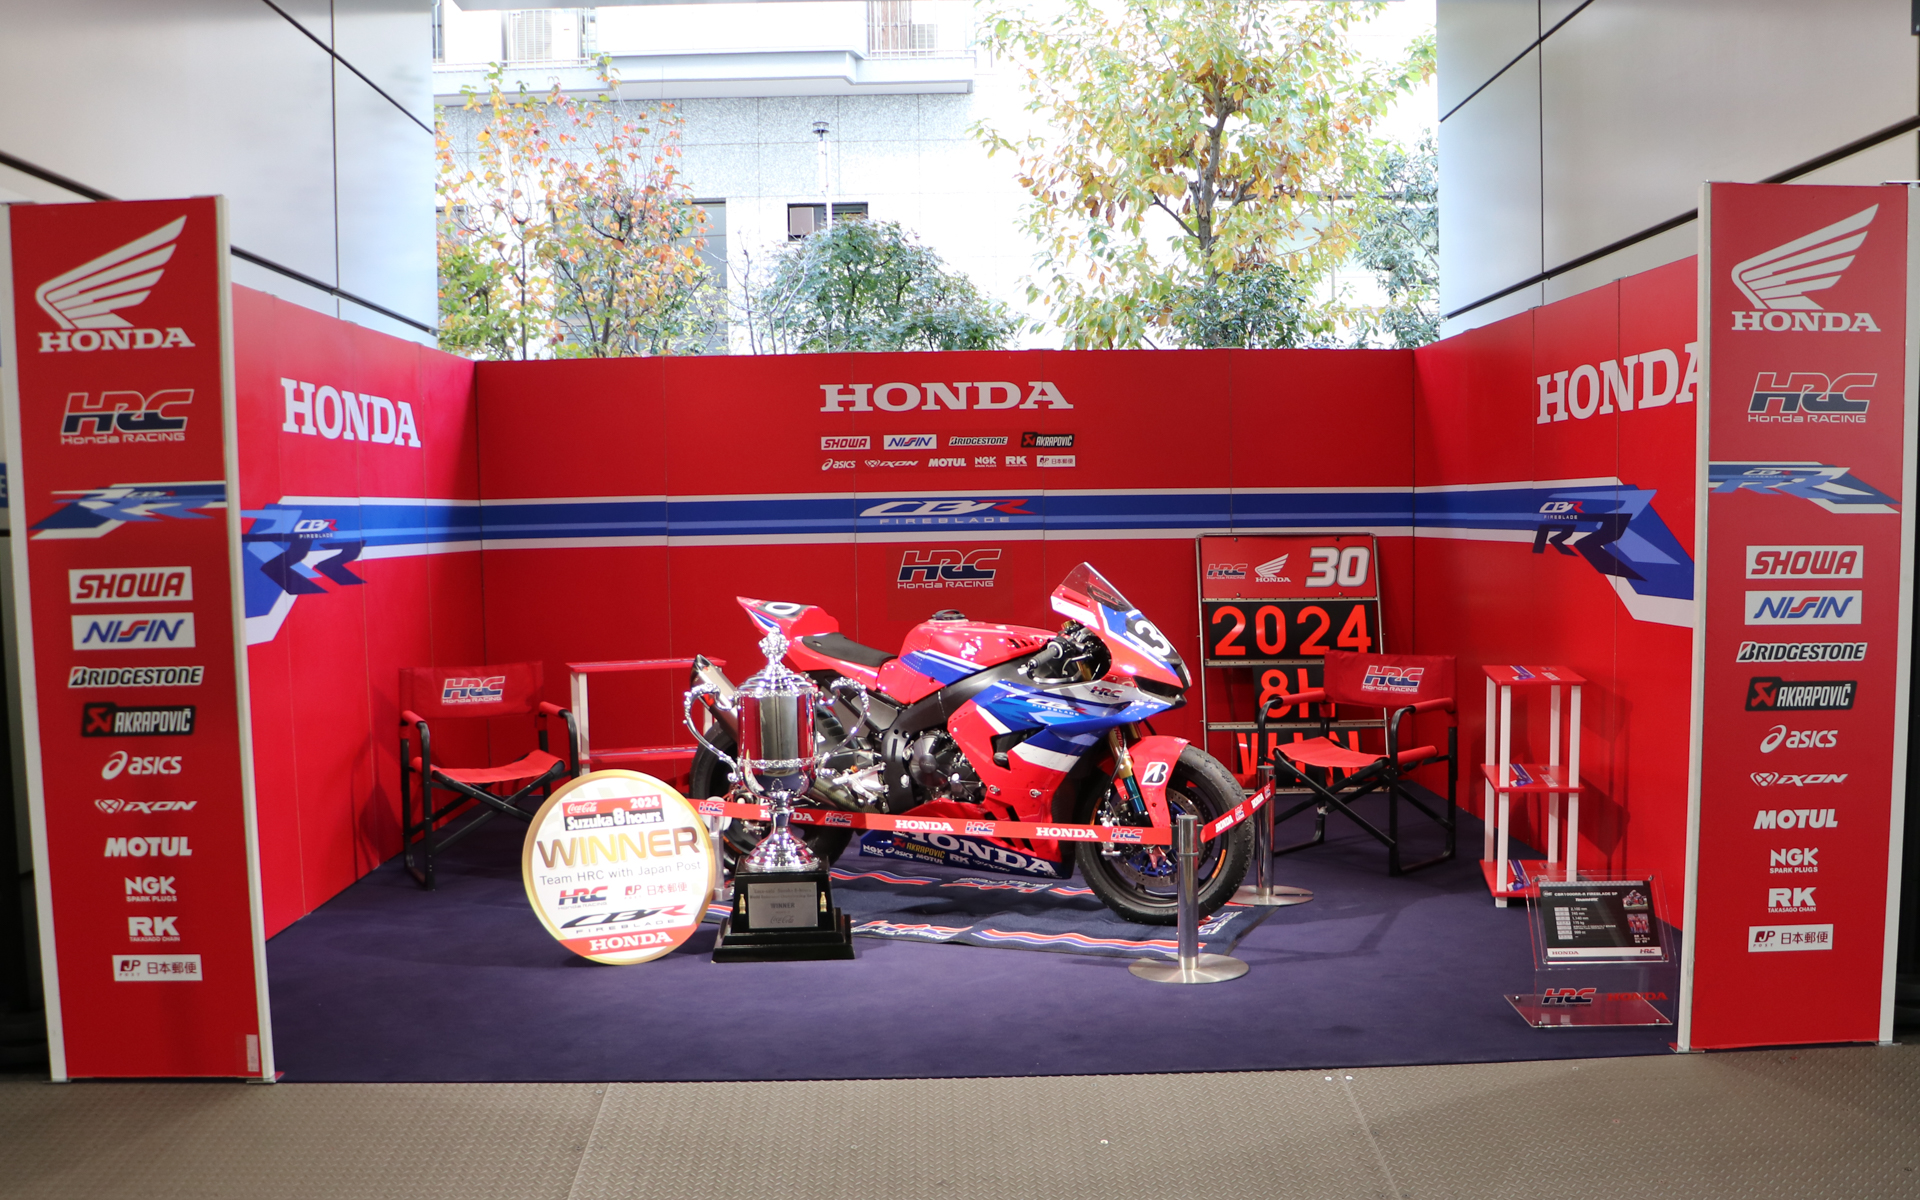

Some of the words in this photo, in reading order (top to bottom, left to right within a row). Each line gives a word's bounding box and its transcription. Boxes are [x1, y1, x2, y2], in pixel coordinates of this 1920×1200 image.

[1731, 311, 1881, 332] HONDA
[38, 327, 195, 352] HONDA
[819, 381, 1074, 412] HONDA
[1747, 372, 1878, 414] HRC
[61, 389, 194, 435] HRC
[280, 377, 421, 448] HONDA
[1748, 414, 1804, 423] Honda
[1806, 414, 1867, 423] RACING
[61, 433, 120, 445] Honda
[122, 432, 186, 443] RACING
[823, 438, 868, 448] SHOWA
[888, 437, 932, 447] NISSIN
[950, 437, 1007, 445] BRIDGESTONE
[928, 457, 966, 467] MOTUL
[975, 456, 996, 465] NGK
[1005, 456, 1027, 465] RK
[859, 499, 1036, 517] CBR
[1538, 501, 1585, 514] CBR
[293, 519, 338, 532] CBR
[879, 516, 1010, 525] FIREBLADE
[897, 549, 1002, 582] HRC
[1207, 563, 1248, 576] HRC
[1305, 546, 1370, 588] 30
[1751, 551, 1857, 575] SHOWA
[76, 572, 185, 599] SHOWA
[897, 581, 943, 589] Honda
[945, 580, 994, 588] RACING
[1753, 596, 1854, 618] NISSIN
[81, 619, 185, 643] NISSIN
[1135, 620, 1171, 656] 3
[1212, 605, 1372, 656] 2024
[1738, 643, 1865, 661] BRIDGESTONE
[71, 667, 202, 686] BRIDGESTONE
[1363, 665, 1424, 688] HRC
[442, 676, 505, 699] HRC
[1090, 686, 1124, 698] HRC
[1777, 683, 1851, 707] AKRAPOVIČ
[1032, 703, 1079, 716] FIREBLADE
[114, 708, 191, 733] AKRAPOVIČ
[1785, 730, 1838, 748] asics
[127, 756, 182, 775] asics
[630, 796, 660, 809] 2024
[699, 801, 725, 812] HRC
[566, 814, 613, 831] Suzuka
[612, 808, 625, 826] 8
[625, 810, 662, 825] hours
[760, 809, 814, 822] HDA
[825, 812, 852, 824] HRC
[1753, 809, 1838, 829] MOTUL
[895, 819, 954, 832] HONDA
[965, 821, 996, 833] HRC
[1036, 826, 1098, 839] HONDA
[1111, 828, 1143, 839] HRC
[104, 837, 192, 857] MOTUL
[537, 826, 700, 869] WINNER
[863, 844, 884, 855] NGK
[916, 853, 943, 865] MOTUL
[949, 853, 970, 865] RK
[1770, 847, 1819, 866] NGK
[540, 874, 572, 886] Team
[577, 870, 604, 882] HRC
[609, 867, 634, 879] with
[638, 864, 672, 876] Japan
[677, 860, 701, 871] Post
[125, 876, 176, 895] NGK
[624, 884, 642, 896] JP
[647, 882, 688, 896] 日本郵便
[558, 885, 608, 906] HRC
[1768, 887, 1816, 907] RK
[560, 904, 695, 929] CBR
[128, 916, 178, 936] RK
[575, 919, 675, 934] FIREBLADE
[589, 931, 673, 952] HONDA
[1754, 930, 1776, 943] JP
[1781, 931, 1828, 945] 日本郵便
[120, 960, 140, 972] JP
[147, 962, 197, 974] 日本郵便
[1541, 988, 1597, 1005] HRC
[1607, 992, 1668, 1002] HONDA
